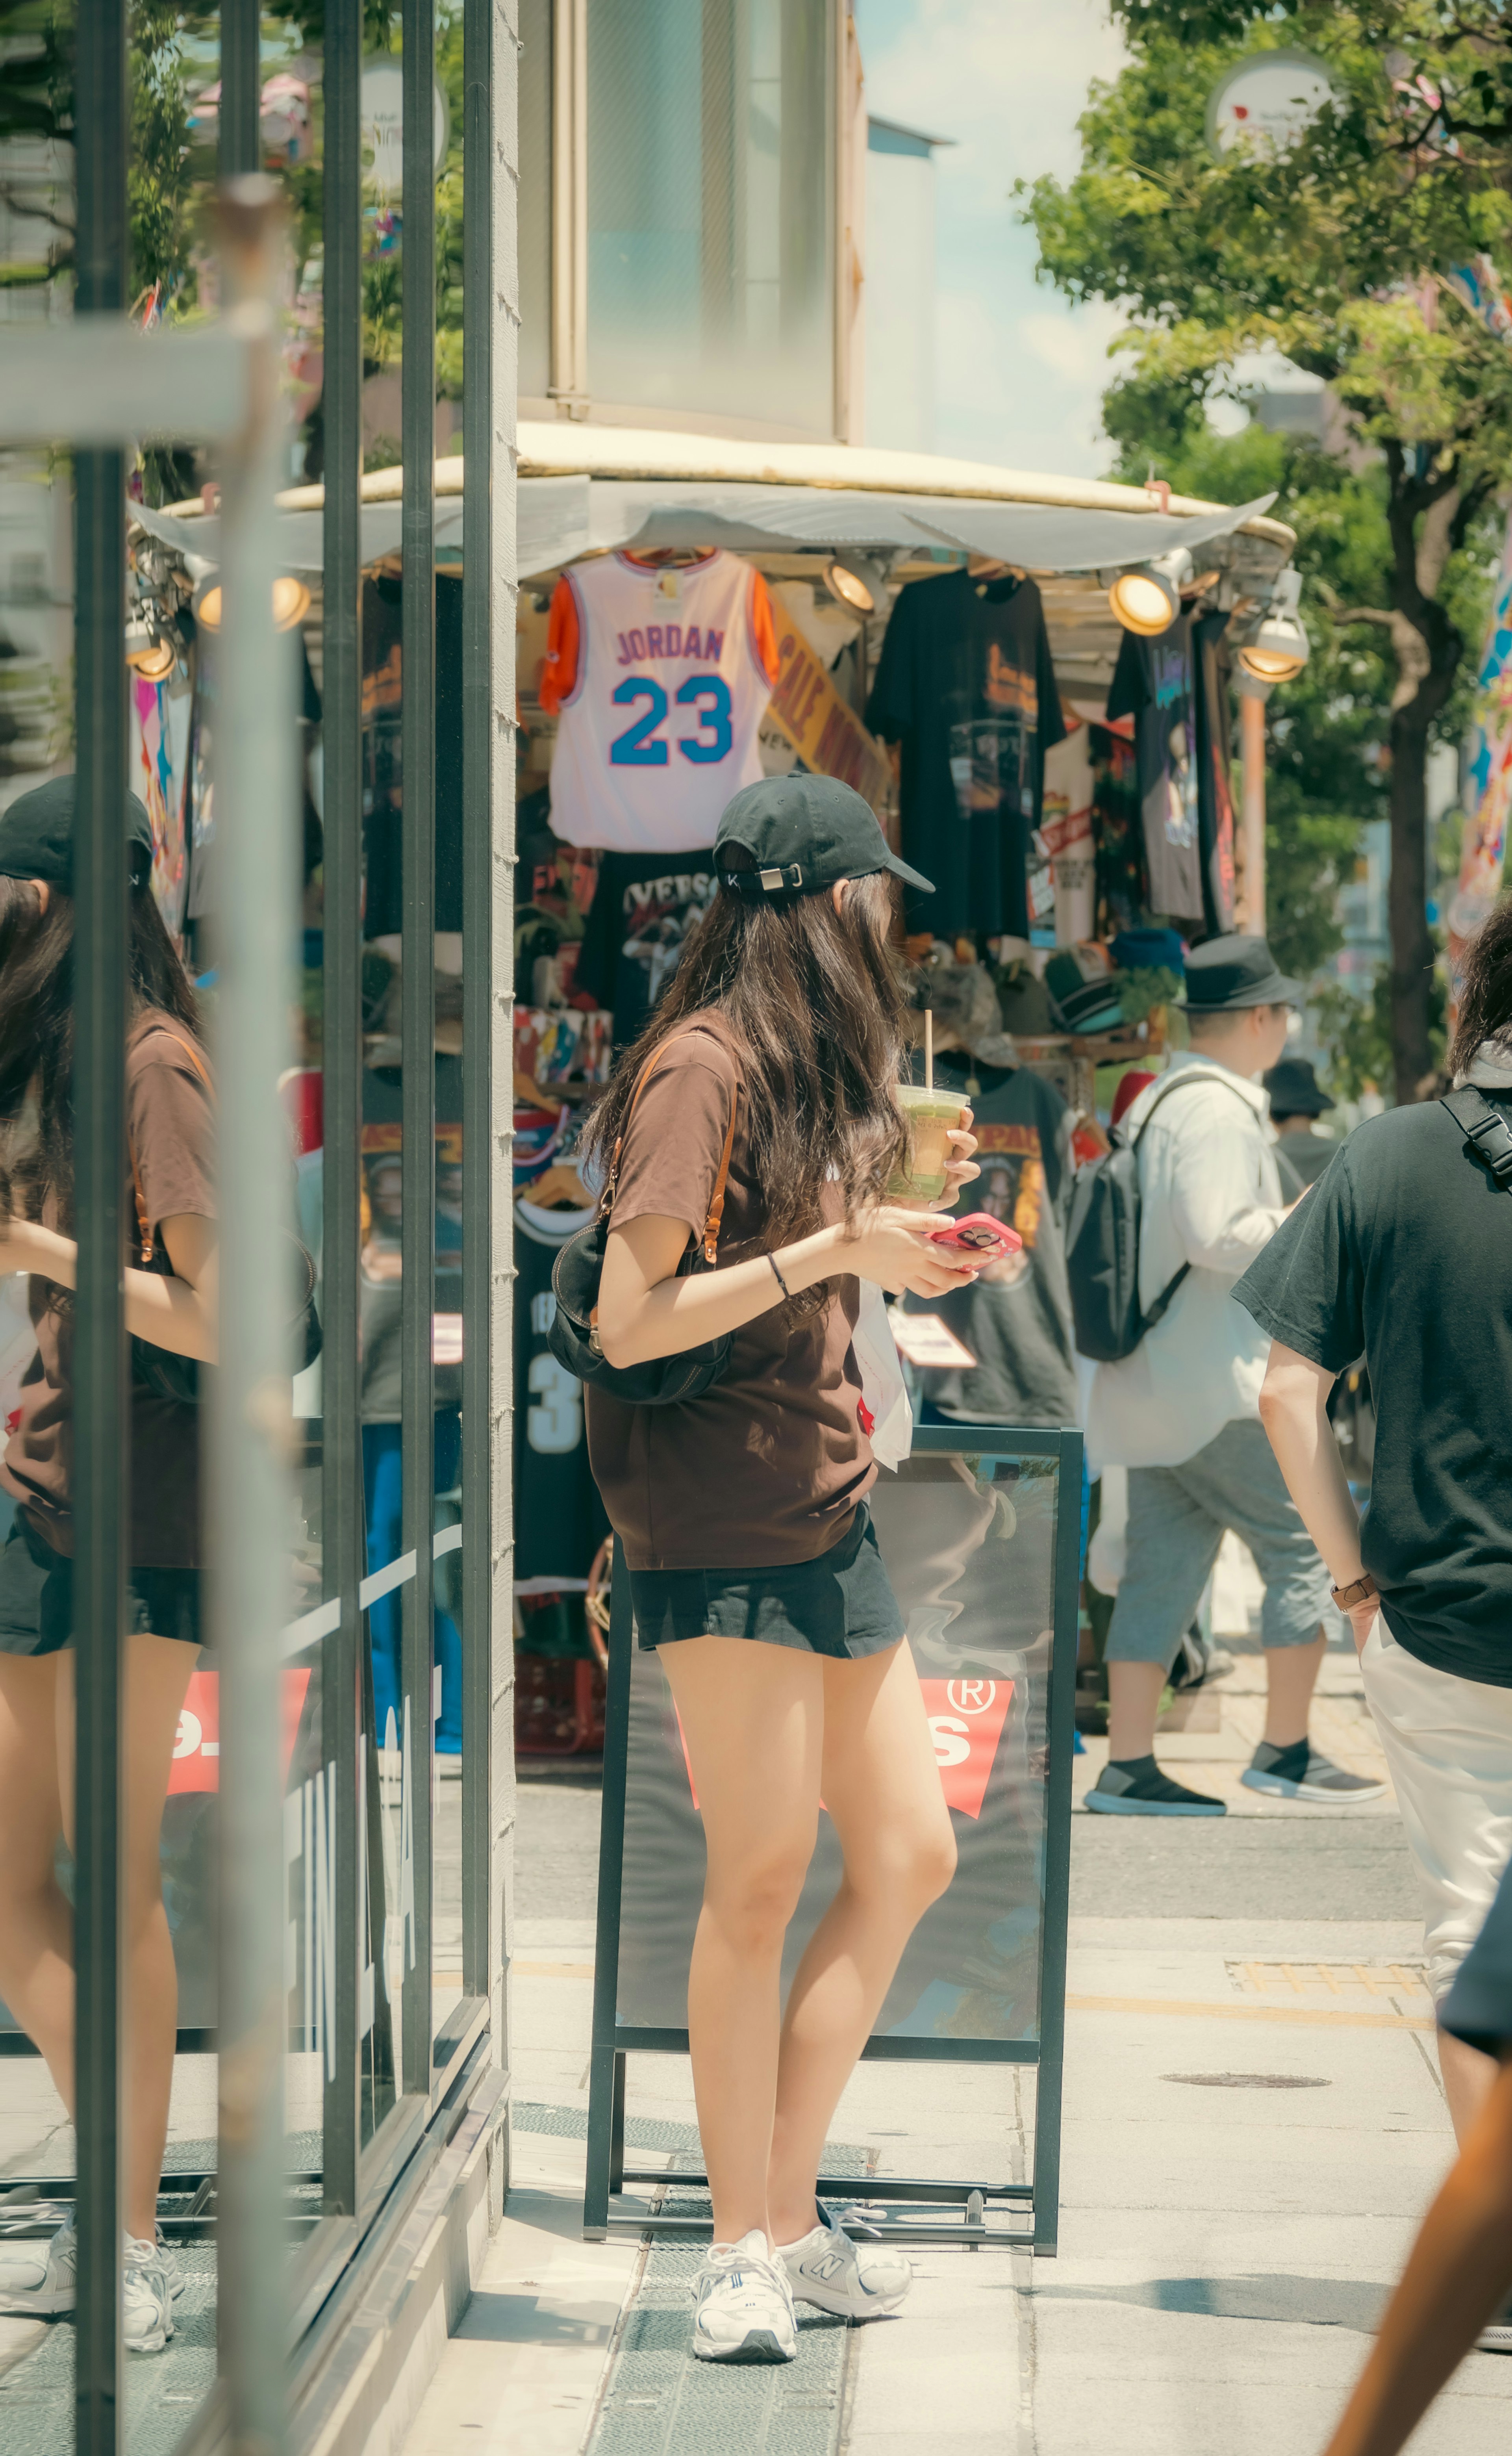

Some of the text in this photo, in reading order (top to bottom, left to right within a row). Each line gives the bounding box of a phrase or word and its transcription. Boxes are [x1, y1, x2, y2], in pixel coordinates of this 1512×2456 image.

[617, 624, 725, 666] JORDAN
[610, 673, 733, 766] 23
[728, 874, 738, 887] K
[527, 1352, 583, 1454] 3
[811, 2253, 845, 2281] N
